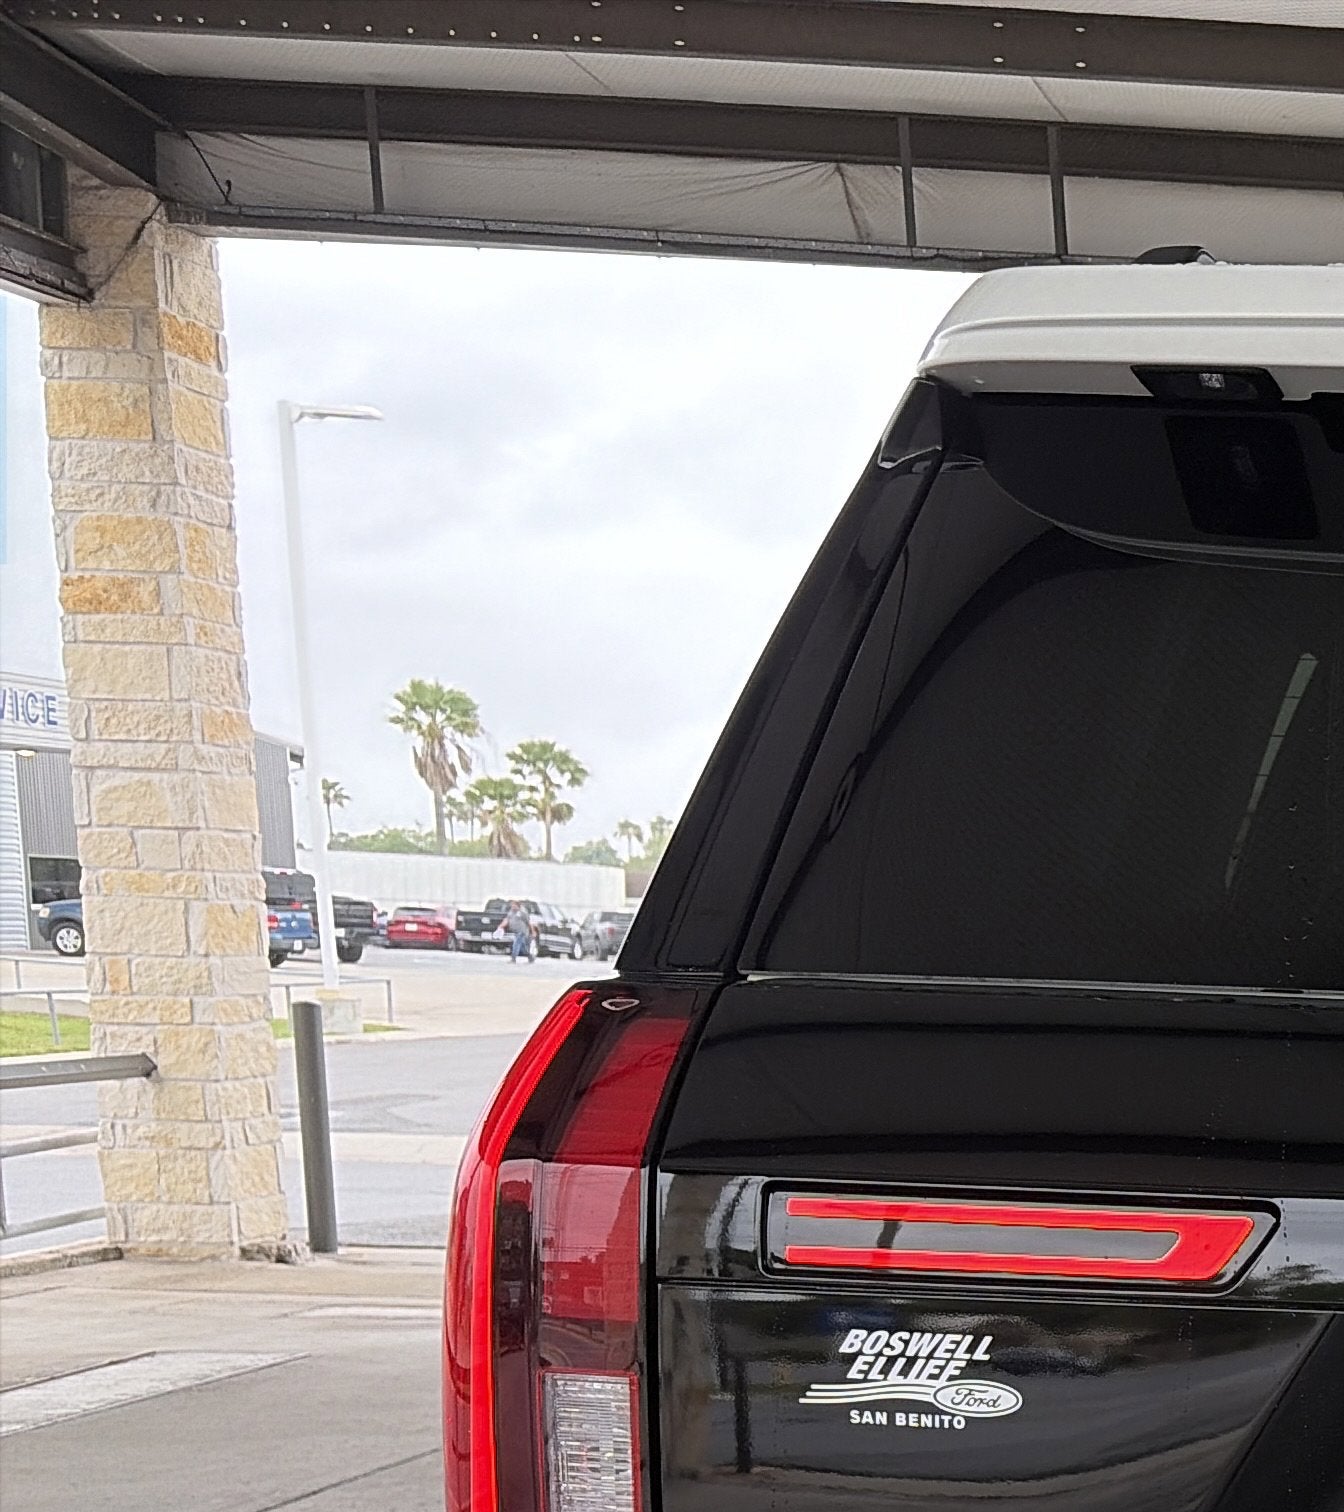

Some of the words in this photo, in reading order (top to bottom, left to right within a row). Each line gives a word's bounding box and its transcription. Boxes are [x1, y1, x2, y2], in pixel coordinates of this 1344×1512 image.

[838, 1328, 993, 1361] BOSWELL
[846, 1355, 968, 1383] ELLIFF
[951, 1386, 1002, 1409] Ford
[850, 1409, 888, 1426] SAN
[895, 1412, 966, 1430] BENITO
